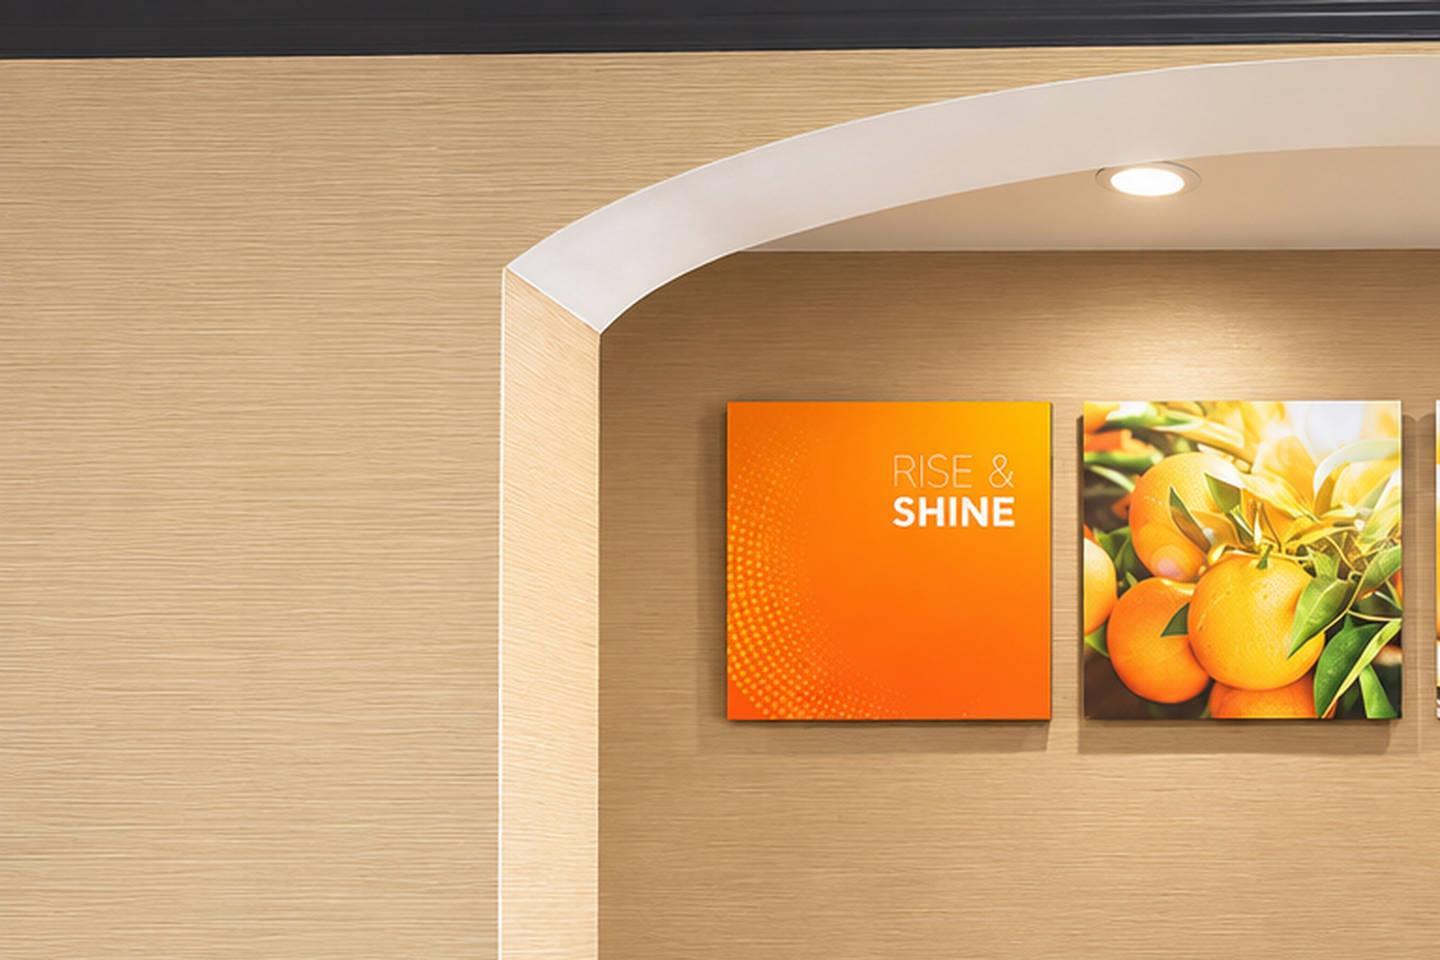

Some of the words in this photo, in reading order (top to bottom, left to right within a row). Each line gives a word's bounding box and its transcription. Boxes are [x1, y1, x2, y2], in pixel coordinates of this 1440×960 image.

[893, 453, 973, 488] RISE
[988, 453, 1015, 488] &
[892, 496, 1016, 528] SHINE
